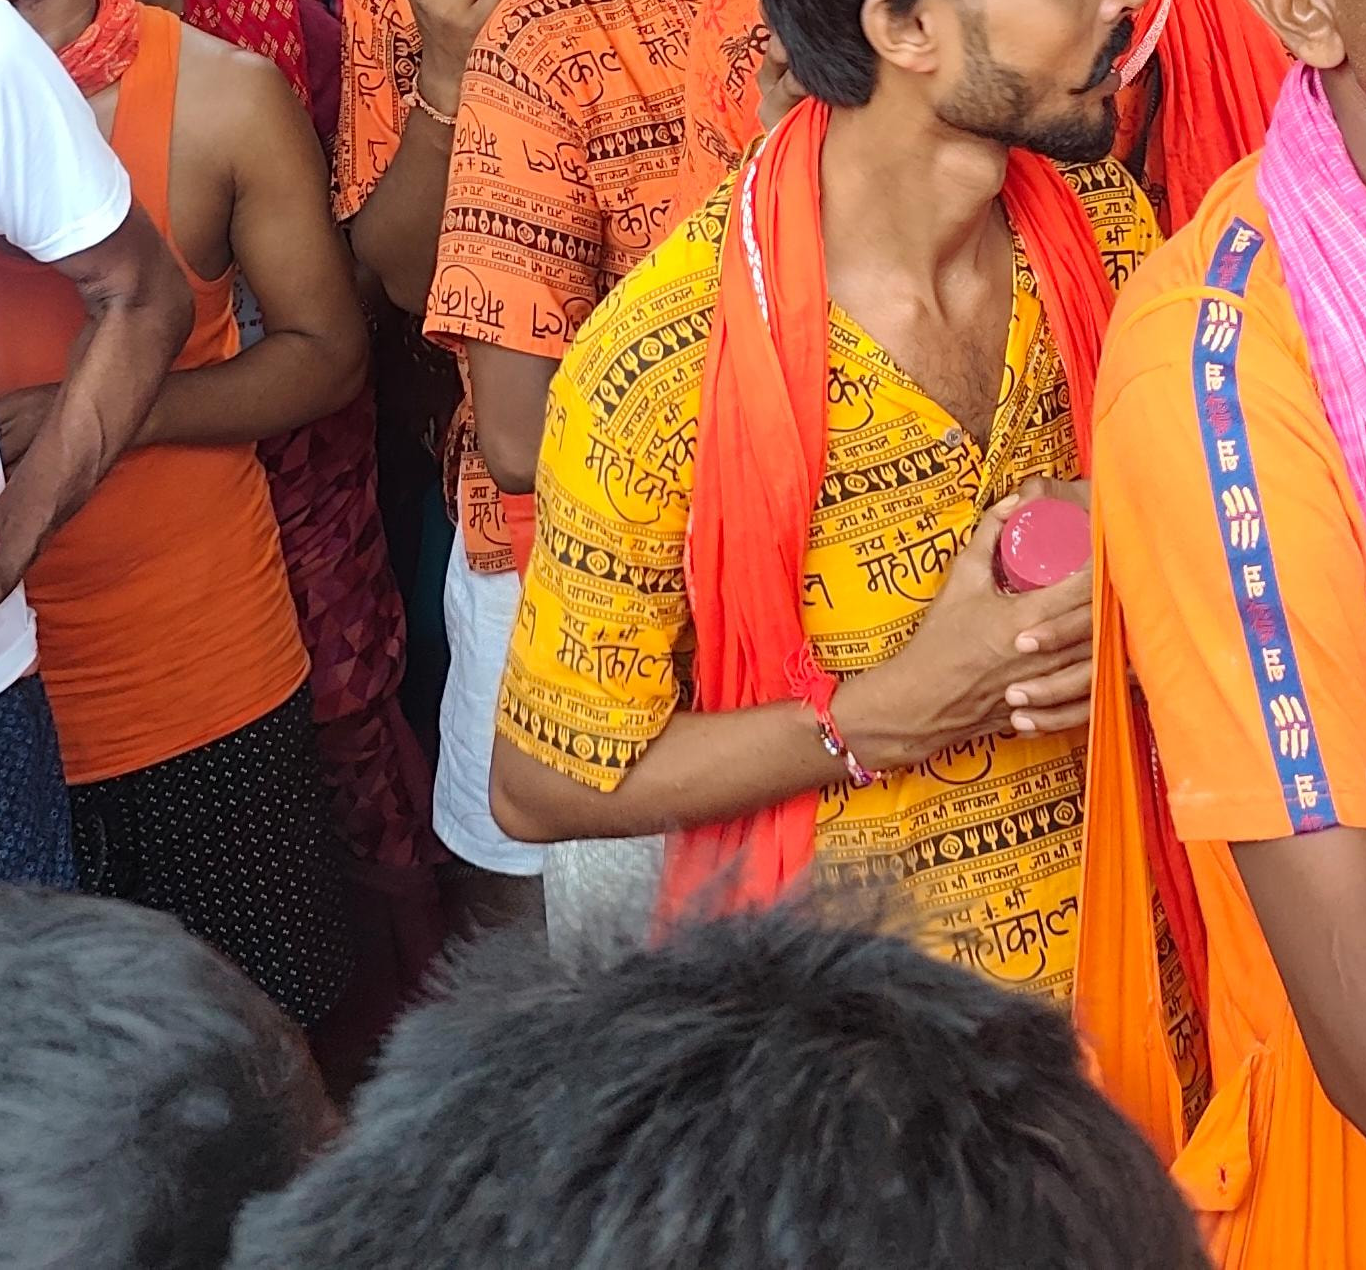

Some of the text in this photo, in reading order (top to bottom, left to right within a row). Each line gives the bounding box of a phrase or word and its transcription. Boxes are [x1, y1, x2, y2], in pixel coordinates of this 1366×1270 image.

[850, 511, 941, 558] जय श्री
[1003, 887, 1034, 911] श्री
